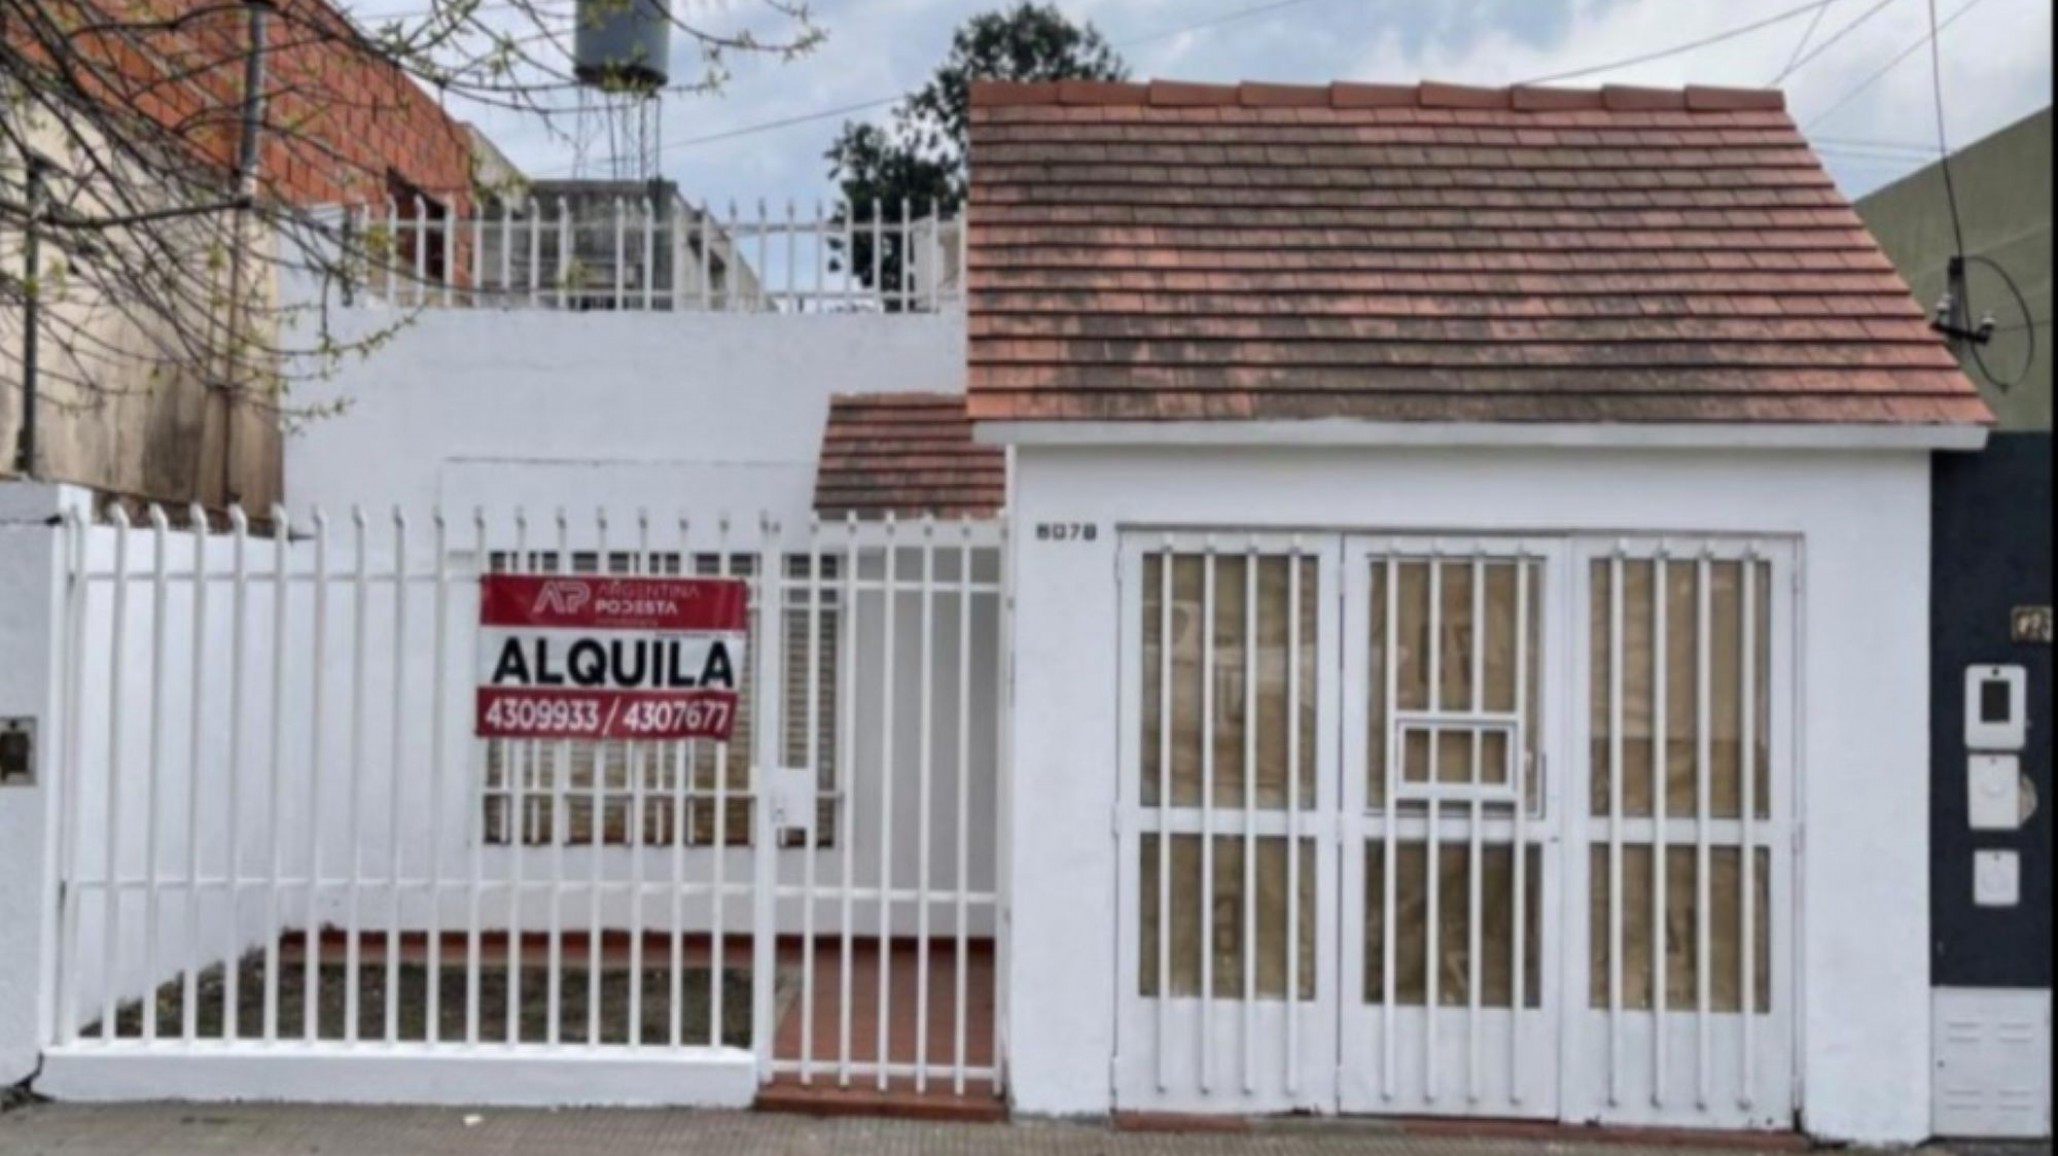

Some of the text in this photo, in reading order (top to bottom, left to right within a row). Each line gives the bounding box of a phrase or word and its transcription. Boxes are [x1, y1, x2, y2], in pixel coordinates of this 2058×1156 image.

[597, 581, 701, 599] ARGENTINA
[492, 636, 734, 688] ALQUILA
[484, 697, 600, 730] 4309933
[622, 700, 730, 733] 4307677
